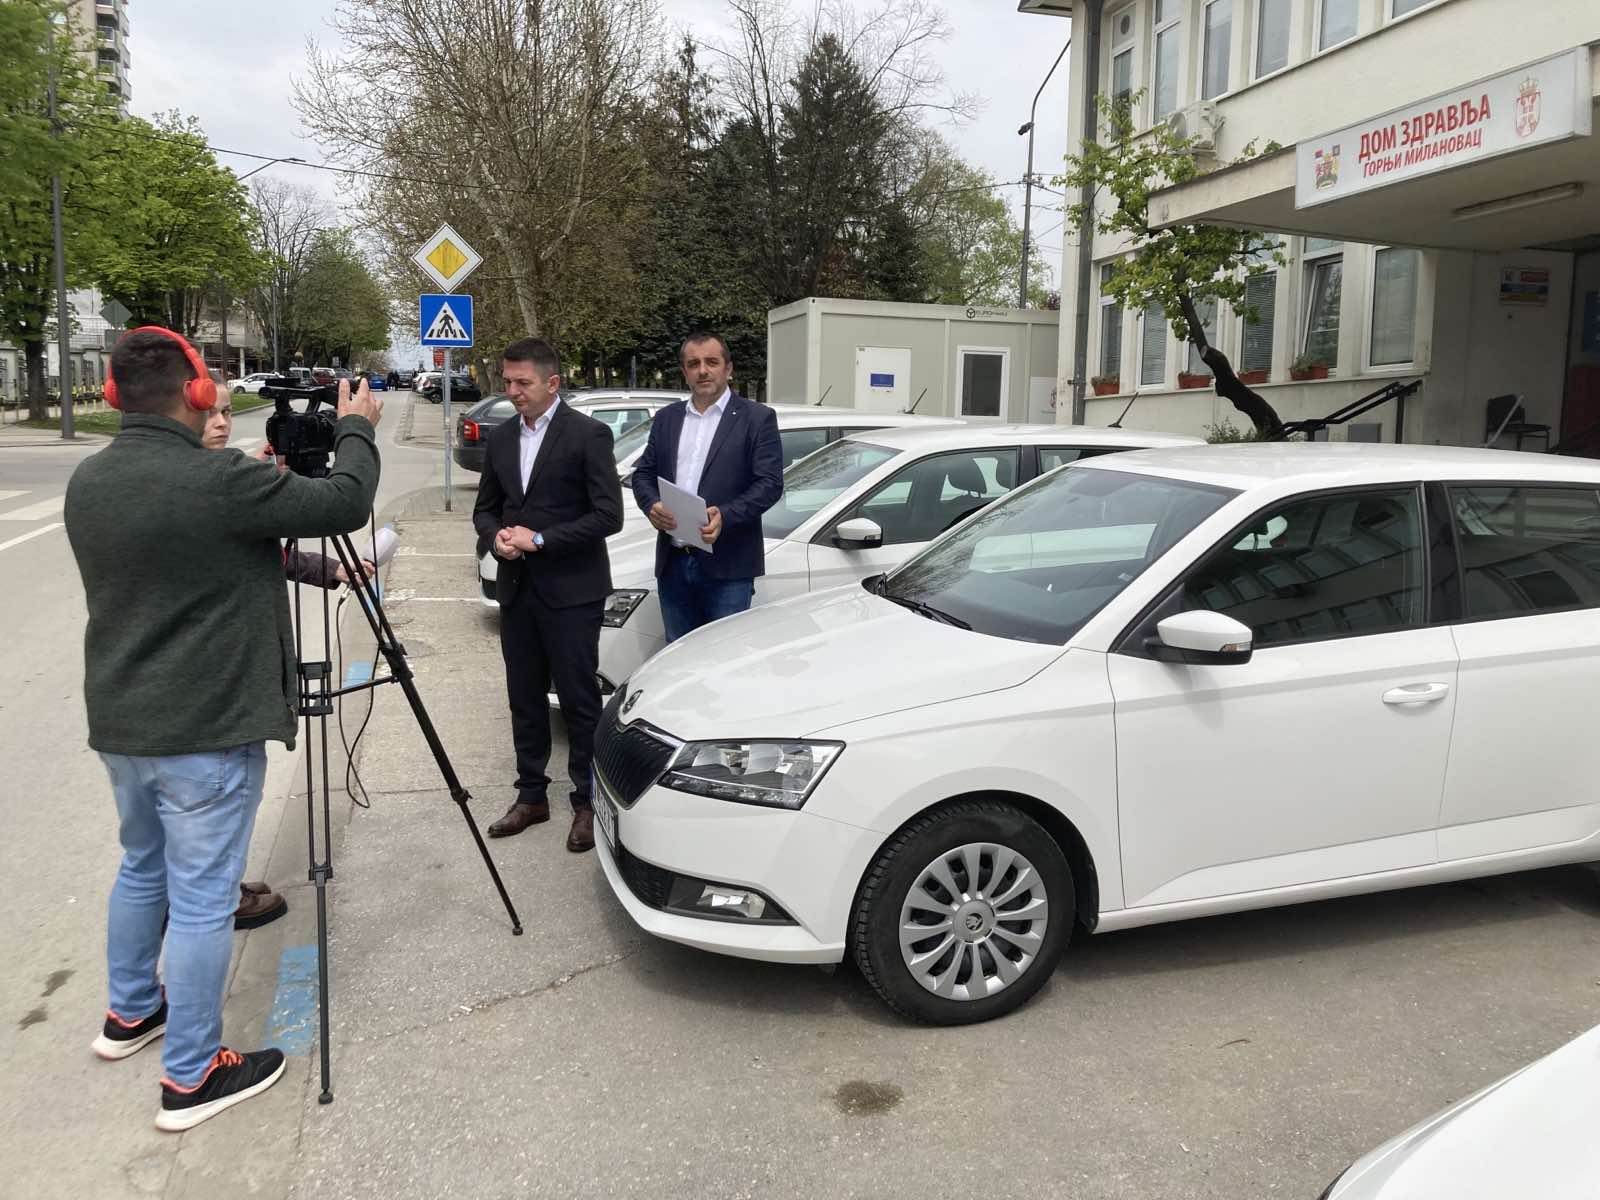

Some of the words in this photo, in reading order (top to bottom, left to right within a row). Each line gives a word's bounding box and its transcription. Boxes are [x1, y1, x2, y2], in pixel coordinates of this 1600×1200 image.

[1359, 124, 1397, 163] ДОМ
[1401, 94, 1491, 147] ЗДРАВЉА
[1363, 154, 1402, 178] ГОРЊИ
[1404, 128, 1483, 167] МИЛАНОВАЦ
